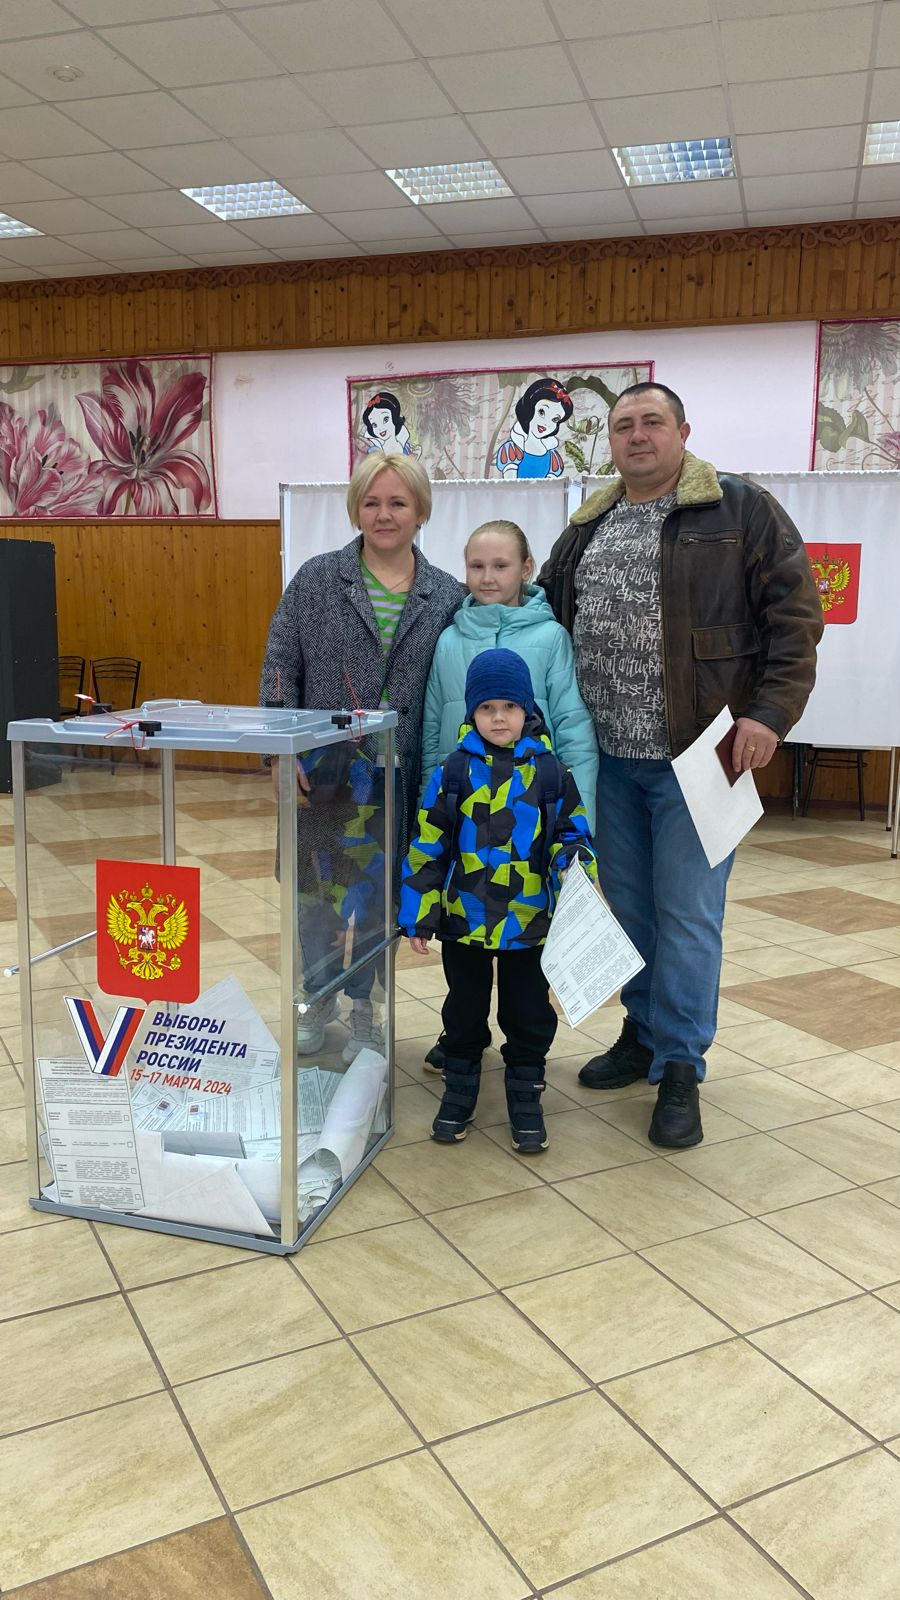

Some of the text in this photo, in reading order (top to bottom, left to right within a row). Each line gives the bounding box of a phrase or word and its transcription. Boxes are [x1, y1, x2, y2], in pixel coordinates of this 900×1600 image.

[152, 1011, 226, 1035] ВЫБОРЫ
[143, 1030, 248, 1059] ПРЕЗИДЕНТА
[135, 1049, 203, 1073] РОССИИ
[162, 1073, 202, 1092] МАРТА
[202, 1079, 232, 1096] 2024
